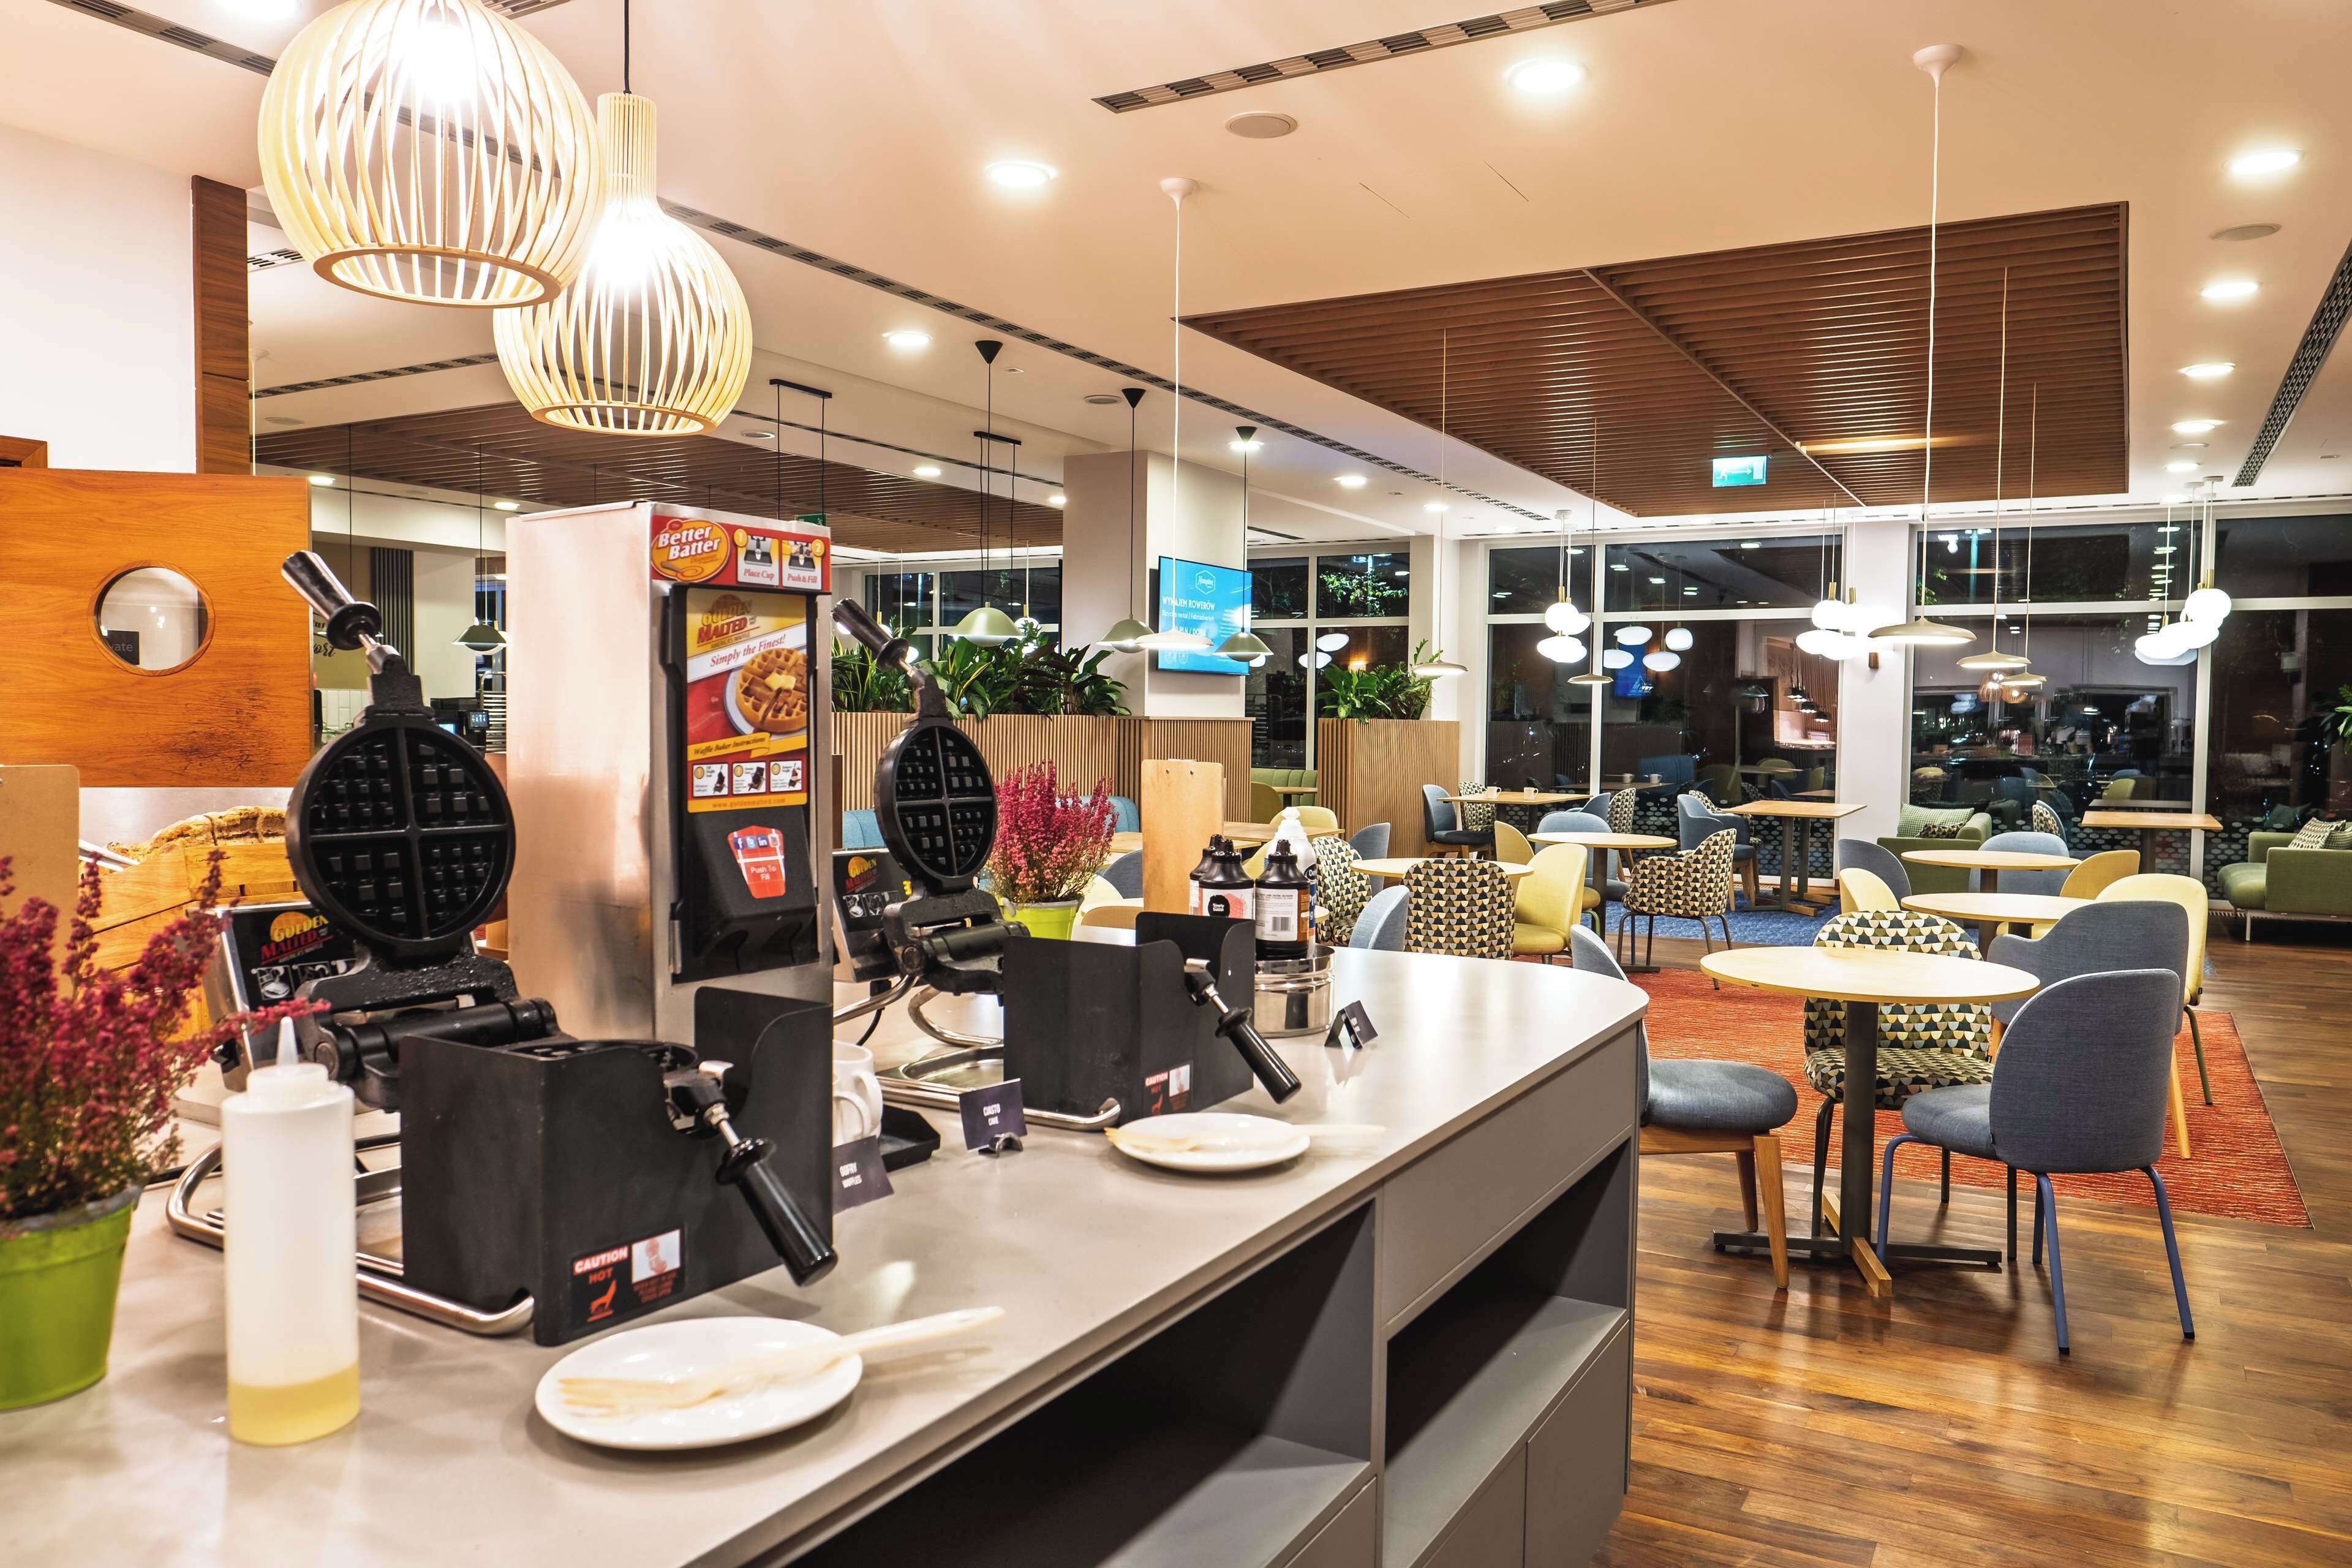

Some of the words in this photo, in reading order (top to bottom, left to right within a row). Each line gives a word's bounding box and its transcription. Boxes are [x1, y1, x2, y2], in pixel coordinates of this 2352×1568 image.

[658, 526, 712, 548] Better
[738, 533, 743, 543] 1
[668, 538, 720, 560] Batter
[815, 543, 821, 552] 2
[744, 568, 760, 578] Place
[761, 570, 774, 581] Cup
[788, 573, 801, 582] Push
[701, 600, 752, 627] GOLDEN
[1188, 599, 1215, 611] ROWERÓW
[697, 617, 747, 644] MALTED
[710, 649, 742, 667] Simply
[743, 644, 755, 656] the
[758, 634, 786, 652] Finest!
[693, 744, 714, 755] Waffle
[714, 742, 731, 752] Baker
[733, 736, 766, 748] Instructions
[274, 914, 330, 943] GOLDEN
[574, 1245, 628, 1273] CAUTION
[589, 1267, 612, 1284] HOT
